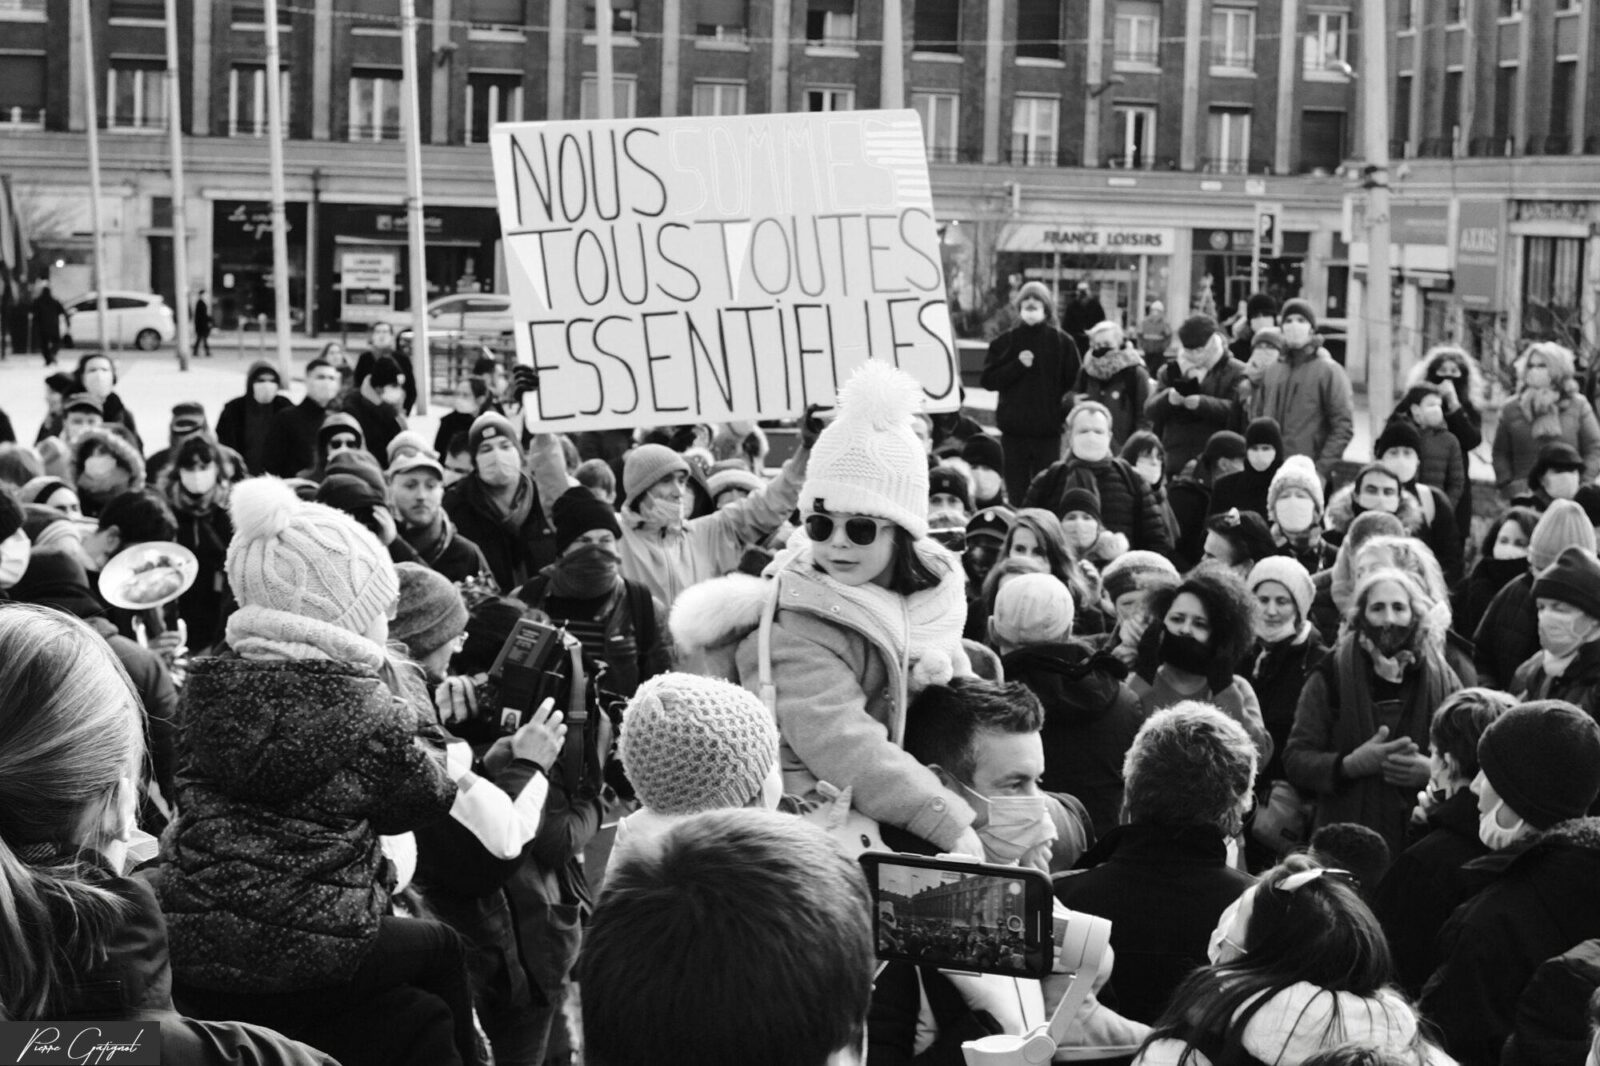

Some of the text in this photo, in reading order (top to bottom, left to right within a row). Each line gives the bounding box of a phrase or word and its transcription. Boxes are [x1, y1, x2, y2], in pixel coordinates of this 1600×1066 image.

[509, 117, 898, 225] NOUS SOMMES
[507, 207, 942, 310] TOUS TOUTES
[1043, 231, 1163, 247] FRANCE LOISIRS
